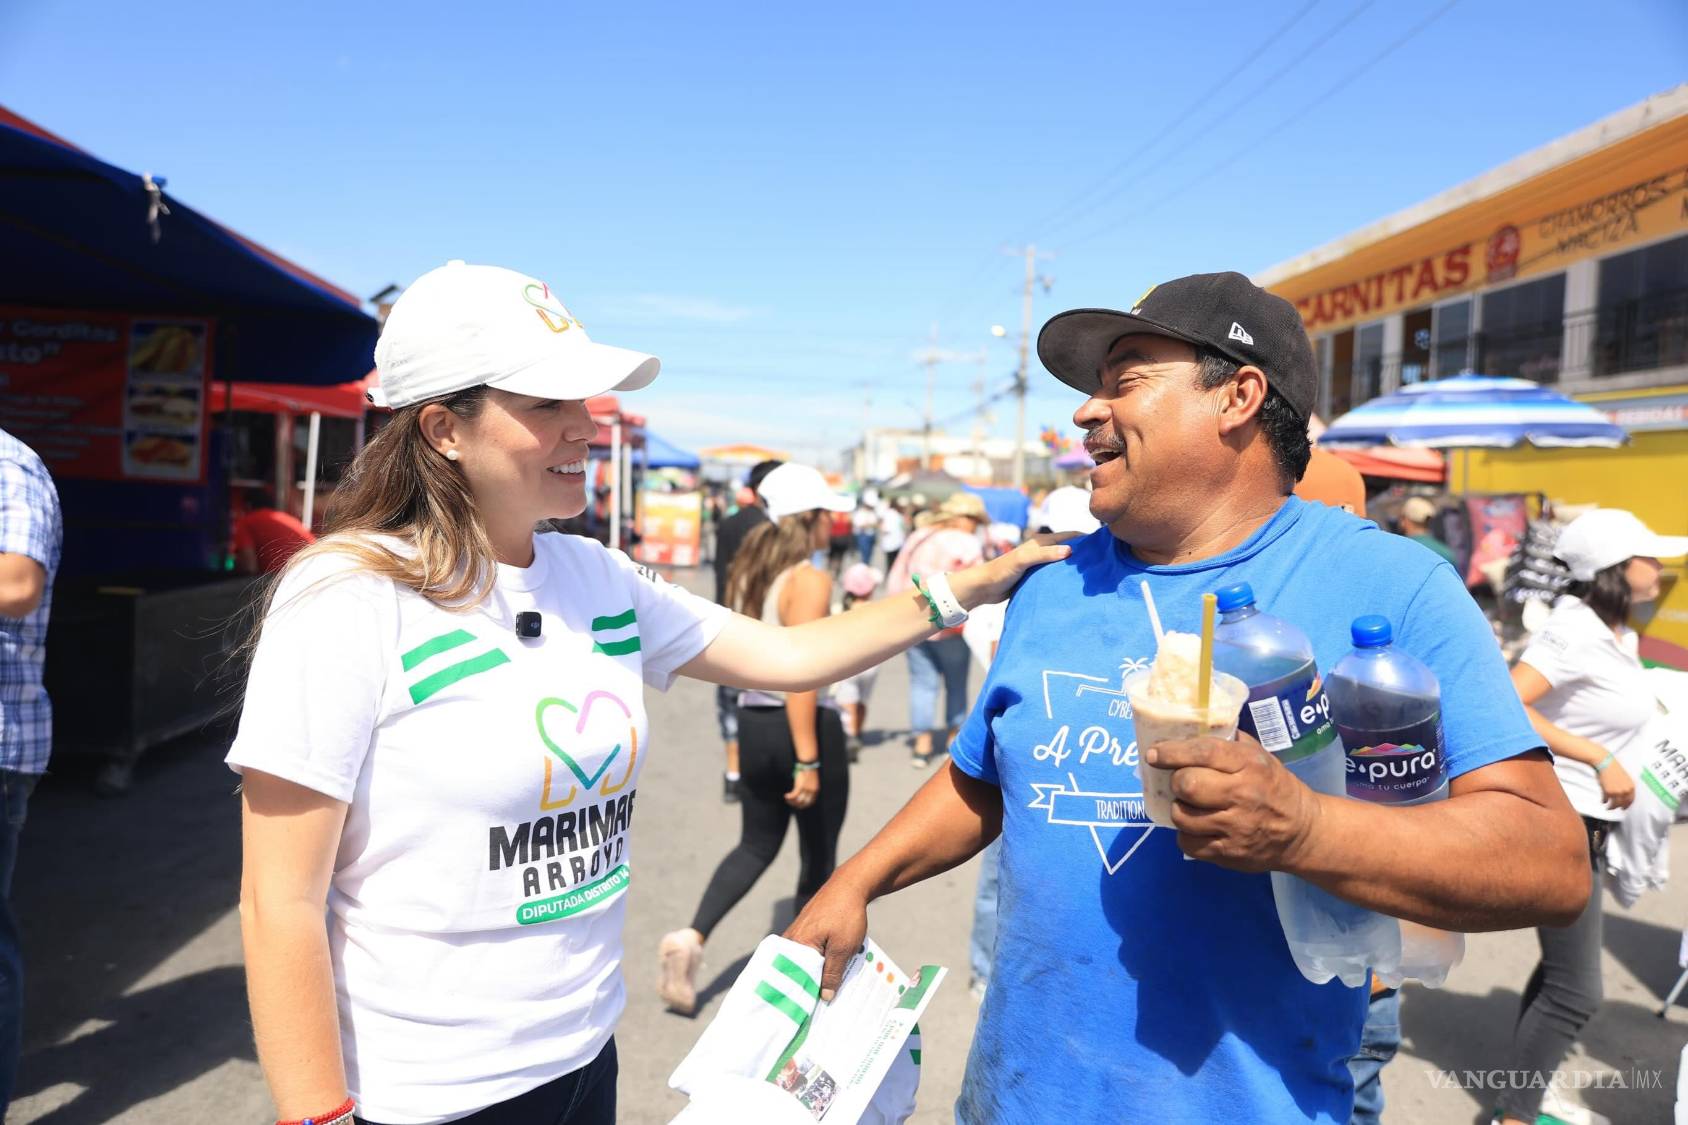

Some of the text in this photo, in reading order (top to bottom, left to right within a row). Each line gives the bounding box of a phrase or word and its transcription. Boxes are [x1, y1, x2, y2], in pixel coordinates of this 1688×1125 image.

[1296, 243, 1472, 327] CARNITAS
[1033, 725, 1071, 768] A
[522, 893, 587, 920] DIPUTADA
[584, 875, 621, 902] DISTRITO
